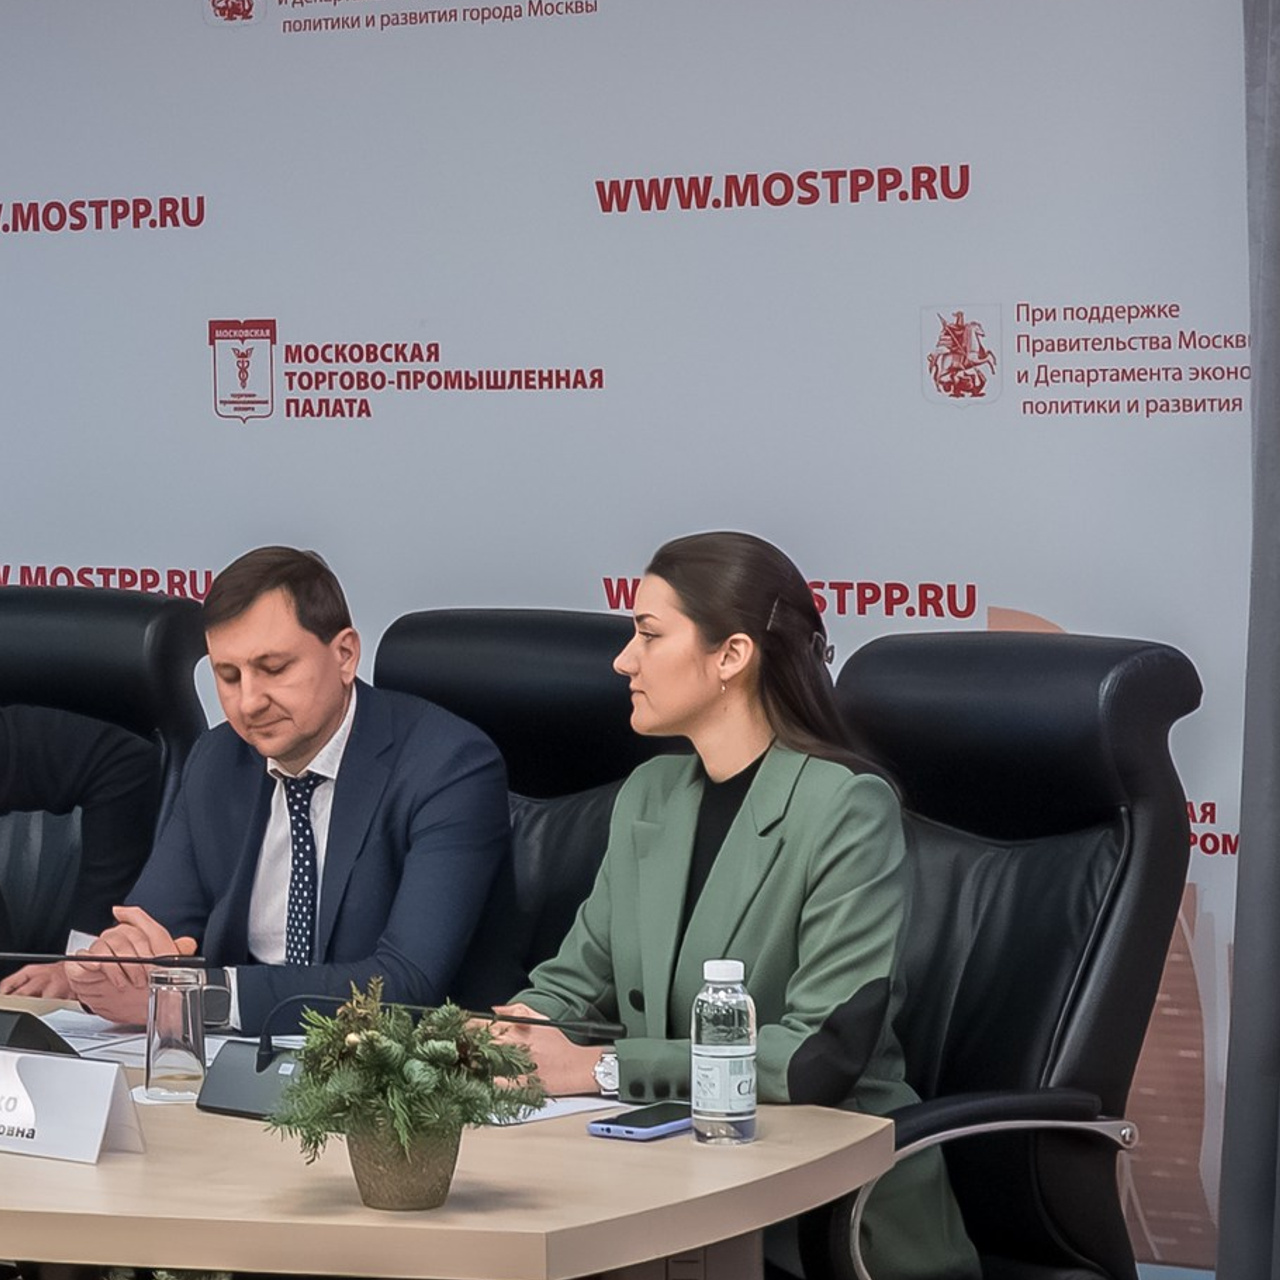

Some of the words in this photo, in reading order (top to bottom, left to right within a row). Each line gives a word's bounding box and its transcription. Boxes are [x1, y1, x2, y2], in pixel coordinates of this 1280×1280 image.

[282, 16, 360, 34] политики
[365, 15, 375, 28] и
[380, 8, 457, 31] развития
[462, 7, 522, 27] города
[595, 164, 970, 213] WWW.MOSTPP.RU
[1016, 303, 1056, 326] При
[1063, 303, 1180, 324] поддержке
[284, 343, 440, 363] МОСКОВСКАЯ
[1016, 334, 1172, 356] Правительства
[285, 369, 604, 391] ТОРГОВО-ПРОМЫШЛЕННАЯ
[1016, 370, 1030, 384] и
[1034, 365, 1183, 388] Департамента
[286, 399, 372, 418] ПАЛАТА
[1022, 401, 1120, 415] политики
[1126, 400, 1140, 414] и
[1145, 398, 1243, 418] развития
[603, 577, 977, 619] WSTPP.RU
